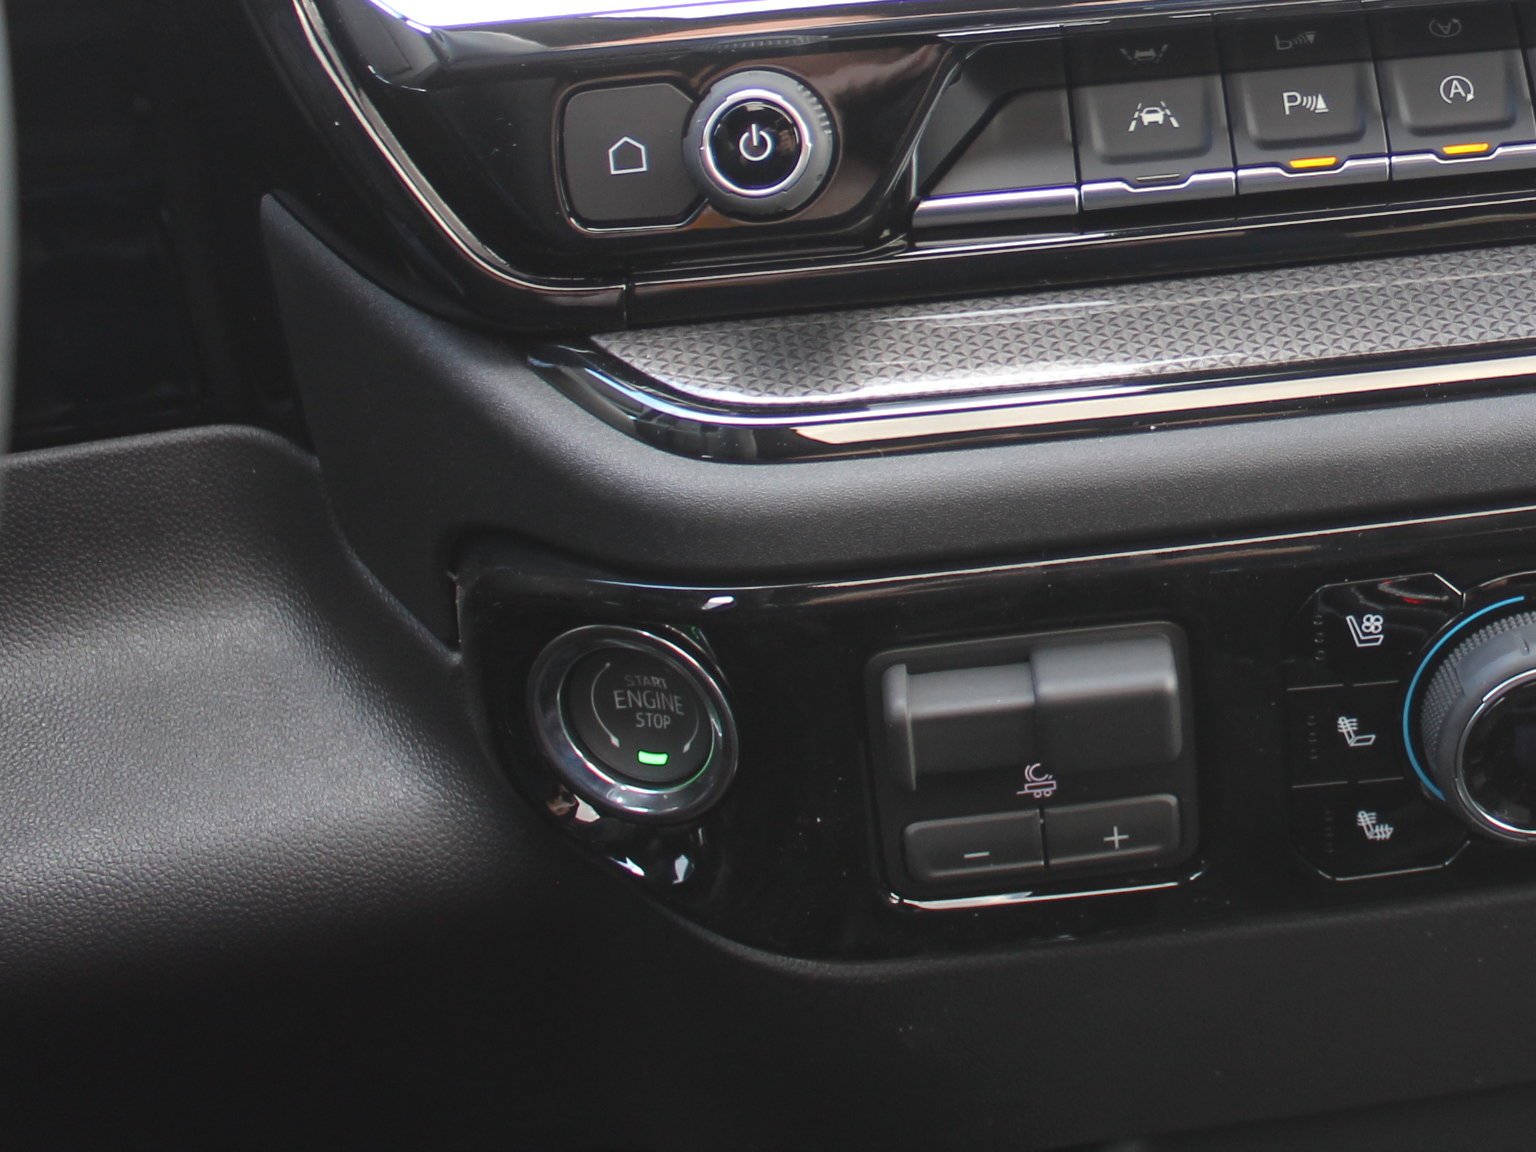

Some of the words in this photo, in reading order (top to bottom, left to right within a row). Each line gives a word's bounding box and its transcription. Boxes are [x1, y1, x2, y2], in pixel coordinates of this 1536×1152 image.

[623, 674, 668, 689] START
[612, 689, 686, 716] ENGINE
[635, 712, 671, 729] STOP
